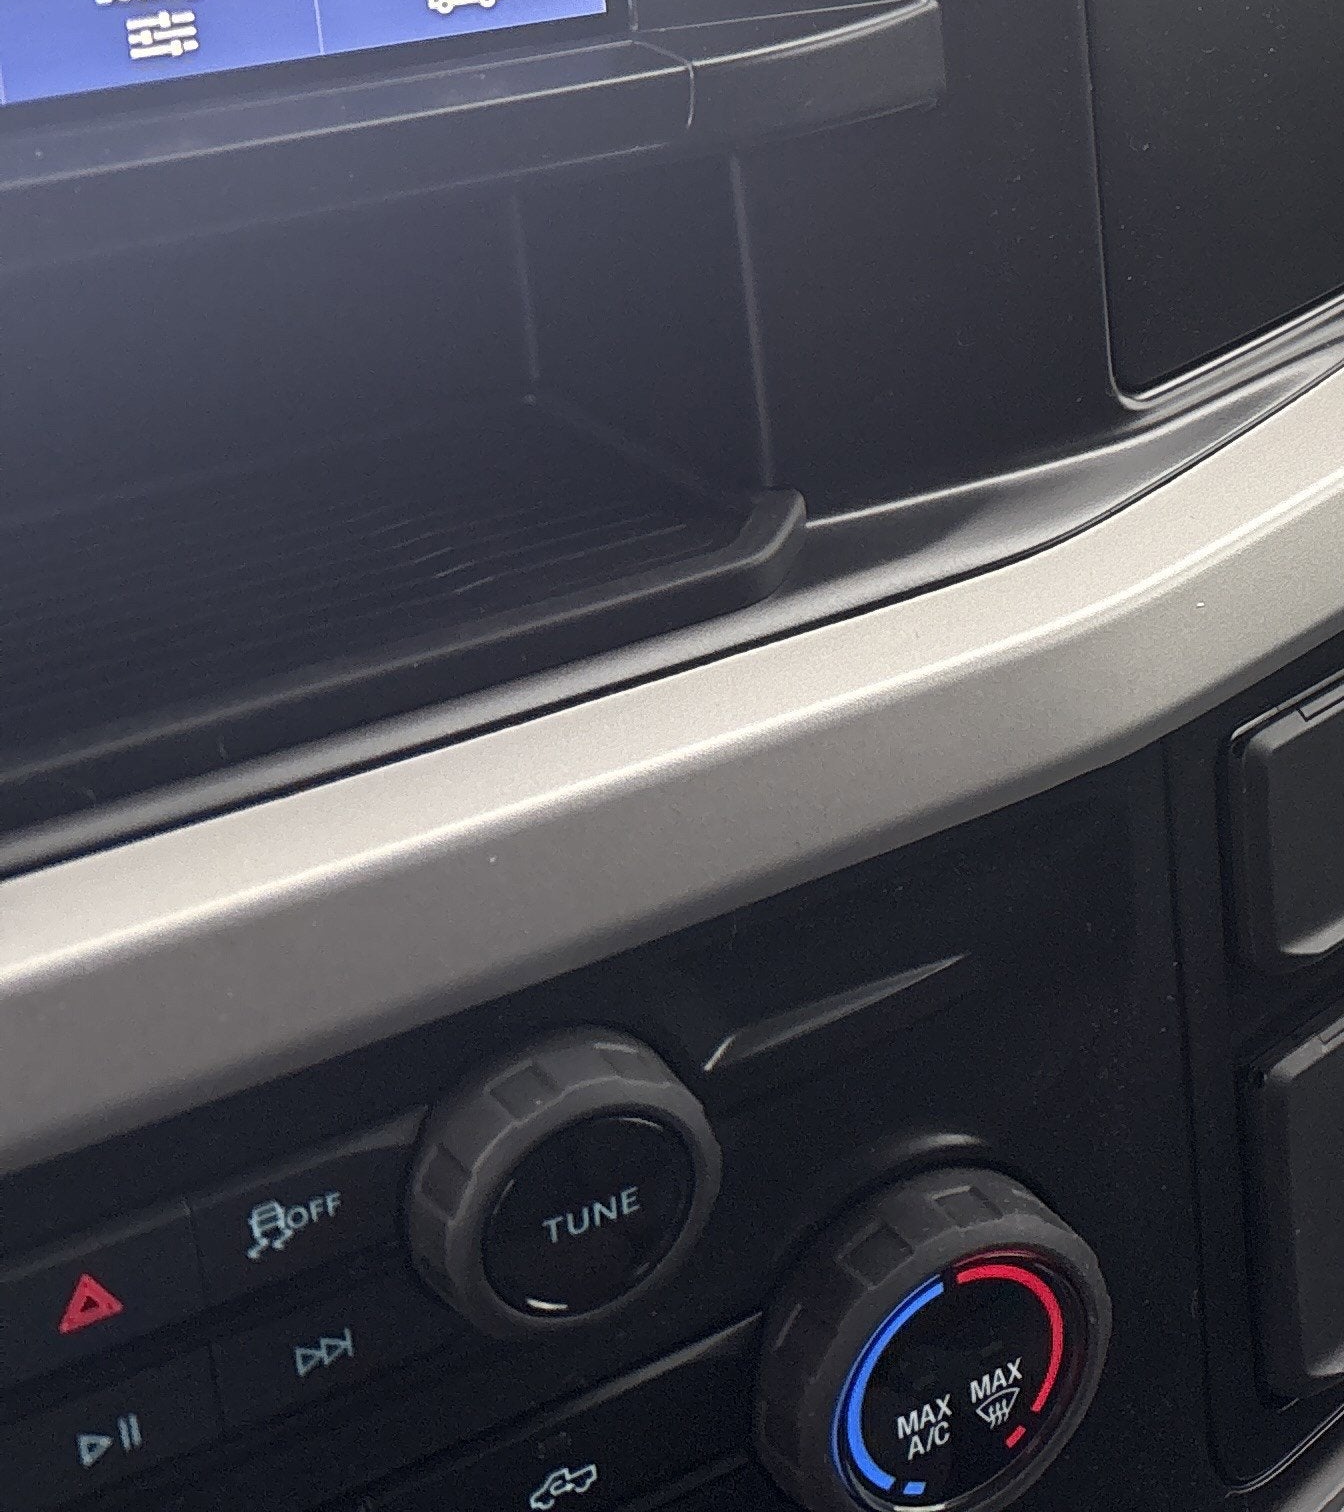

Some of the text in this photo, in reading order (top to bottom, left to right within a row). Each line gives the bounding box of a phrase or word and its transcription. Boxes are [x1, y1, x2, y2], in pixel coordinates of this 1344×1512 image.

[286, 1191, 344, 1233] OFF
[542, 1187, 641, 1244] TUNE
[970, 1356, 1024, 1405] MAX
[896, 1393, 953, 1440] MAX
[907, 1422, 951, 1461] A/C
